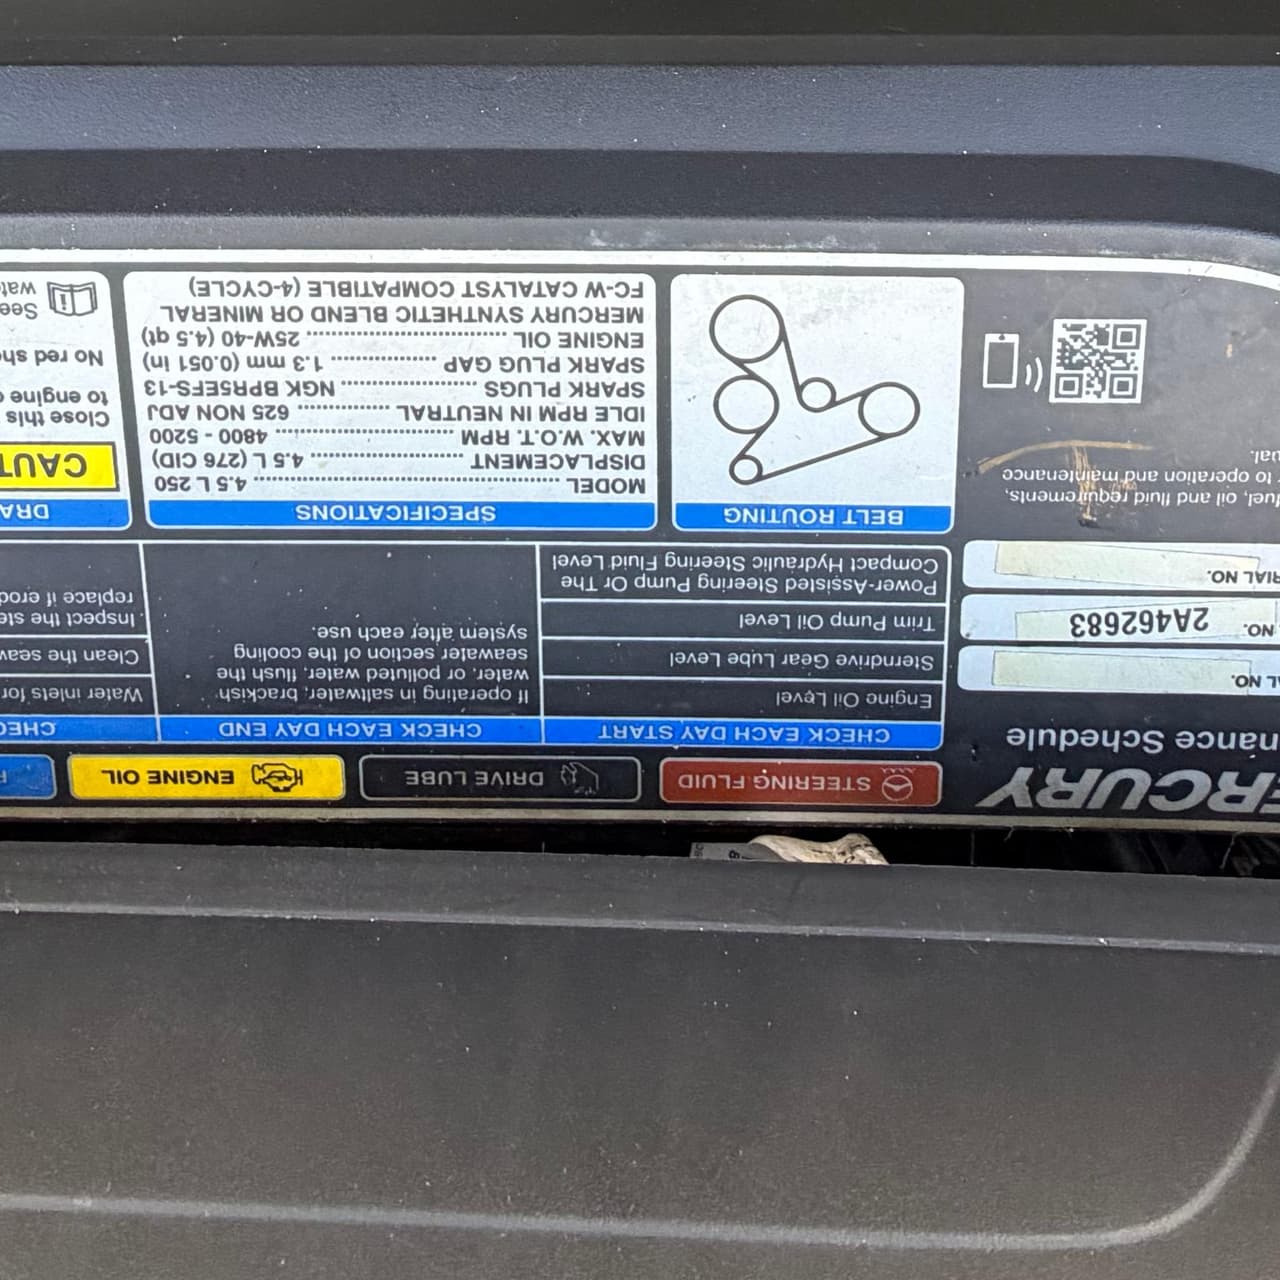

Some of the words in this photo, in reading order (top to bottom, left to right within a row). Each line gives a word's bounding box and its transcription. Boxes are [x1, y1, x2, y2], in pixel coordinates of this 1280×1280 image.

[188, 275, 301, 298] (4-CYCLE)
[307, 280, 455, 299] COMPATIBLE
[461, 280, 578, 299] CATALYST
[584, 281, 644, 299] FC-W
[159, 305, 264, 323] MINERAL
[270, 305, 304, 323] OR
[310, 306, 388, 323] BLEND
[395, 305, 524, 324] SYNTHETIC
[530, 306, 644, 324] MERCURY
[141, 325, 170, 348] qt)
[176, 326, 215, 348] (4.5
[221, 330, 300, 348] 25W-40
[513, 331, 551, 349] OIL
[557, 331, 644, 349] ENGINE
[34, 349, 68, 367] red
[74, 349, 104, 367] No
[142, 351, 170, 373] in)
[178, 351, 240, 373] (0.051
[246, 355, 286, 369] mm
[292, 355, 324, 373] 1.3
[443, 356, 492, 374] GAP
[499, 356, 561, 373] PLUG
[567, 356, 645, 374] SPARK
[144, 379, 279, 397] BPR5EFS-13
[285, 380, 335, 397] NGK
[484, 380, 561, 398] PLUGS
[568, 381, 645, 399] SPARK
[9, 386, 82, 408] engine
[87, 390, 109, 407] to
[5, 410, 46, 428] this
[49, 410, 110, 428] Close
[147, 404, 190, 421] ADJ
[196, 404, 245, 421] NON
[252, 404, 289, 421] 625
[396, 405, 503, 422] NEUTRAL
[510, 405, 532, 422] IN
[539, 405, 588, 422] RPM
[594, 406, 645, 423] IDLE
[149, 428, 199, 445] 5200
[218, 428, 268, 445] 4800
[461, 429, 510, 446] RPM
[517, 429, 584, 446] W.O.T.
[590, 430, 646, 447] MAX.
[151, 448, 198, 470] CID)
[203, 448, 248, 469] (276
[252, 452, 267, 469] L
[273, 452, 304, 469] 4.5
[470, 453, 646, 471] DISPLACEMENT
[154, 475, 191, 492] 250
[196, 476, 211, 493] L
[216, 476, 247, 492] 4.5
[566, 478, 646, 495] MODEL
[295, 504, 496, 522] SPECIFICATIONS
[724, 507, 835, 525] ROUTING
[842, 509, 904, 526] BELT
[1207, 570, 1238, 584] NO.
[739, 613, 791, 630] Level
[797, 614, 824, 631] Oil
[830, 611, 887, 632] Pump
[893, 615, 936, 632] Trim
[1069, 606, 1209, 638] 2A462683
[1243, 623, 1275, 637] NO.
[670, 651, 721, 668] Level
[727, 649, 775, 669] Lube
[781, 653, 830, 670] Gear
[835, 654, 934, 672] Sterndrive
[1231, 674, 1262, 688] NO.
[776, 689, 827, 708] Level
[833, 692, 860, 708] Oil
[865, 689, 933, 709] Engine
[218, 722, 267, 737] END
[275, 722, 320, 737] DAY
[327, 722, 392, 737] EACH
[400, 723, 482, 738] CHECK
[598, 725, 673, 740] START
[681, 725, 727, 741] DAY
[734, 726, 799, 742] EACH
[808, 727, 890, 743] CHECK
[1006, 727, 1165, 754] Schedule
[101, 769, 140, 785] OIL
[146, 769, 235, 785] ENGINE
[404, 770, 467, 786] LUBE
[474, 770, 544, 786] DRIVE
[678, 774, 745, 790] FLUID
[753, 770, 871, 791] STEERING
